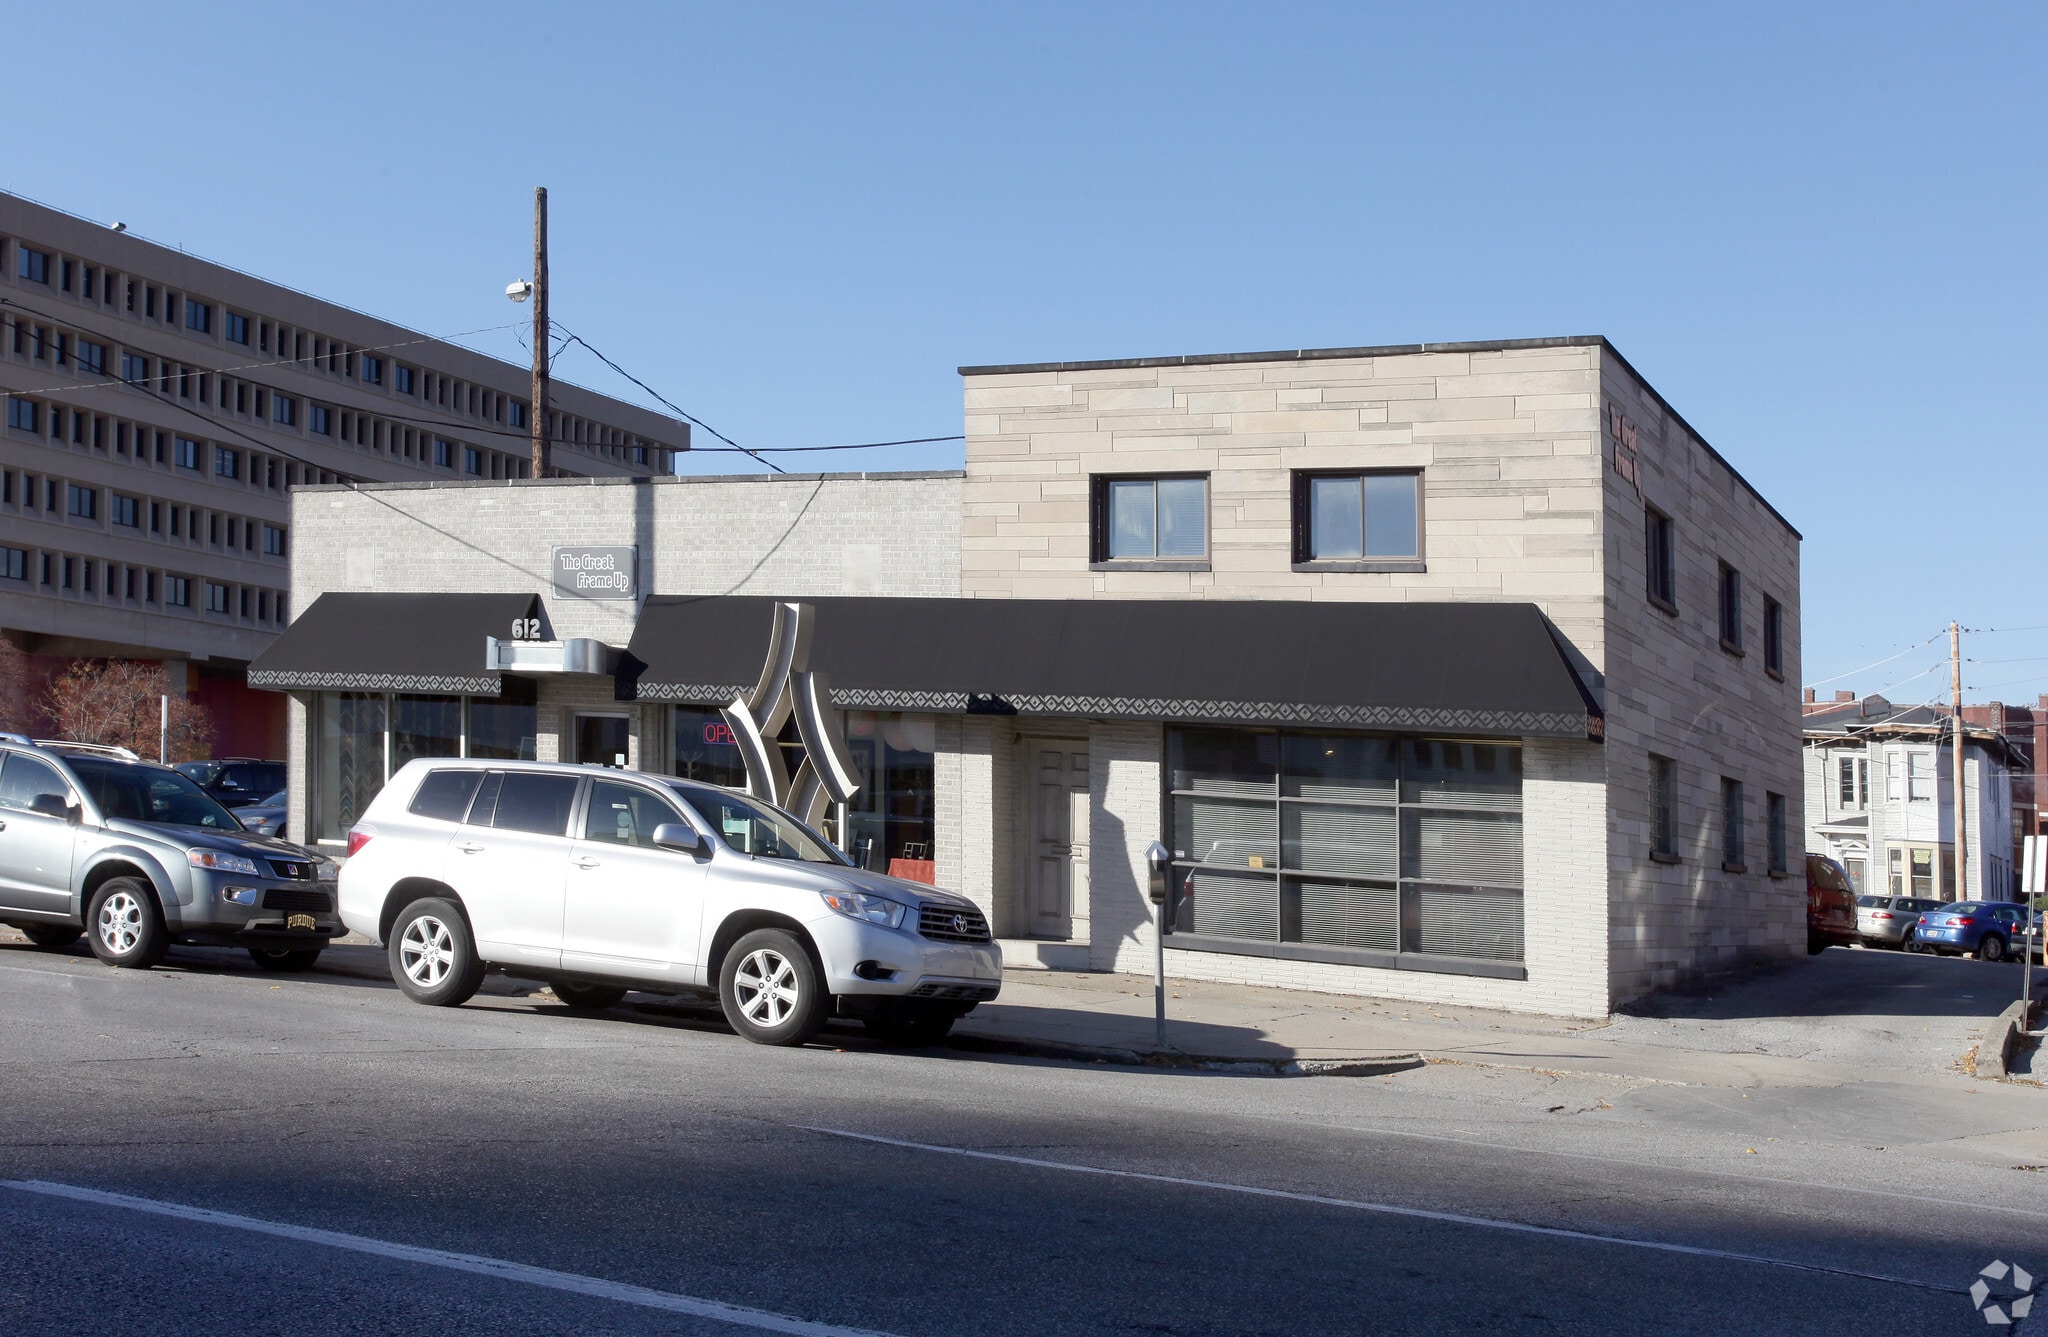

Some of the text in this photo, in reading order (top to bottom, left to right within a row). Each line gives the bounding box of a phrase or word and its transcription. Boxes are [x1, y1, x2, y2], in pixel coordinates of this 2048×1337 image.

[561, 554, 614, 570] The Great
[577, 572, 628, 592] Frame Up
[512, 618, 540, 639] 612
[705, 724, 736, 743] OPE
[287, 914, 316, 930] PURDUE
